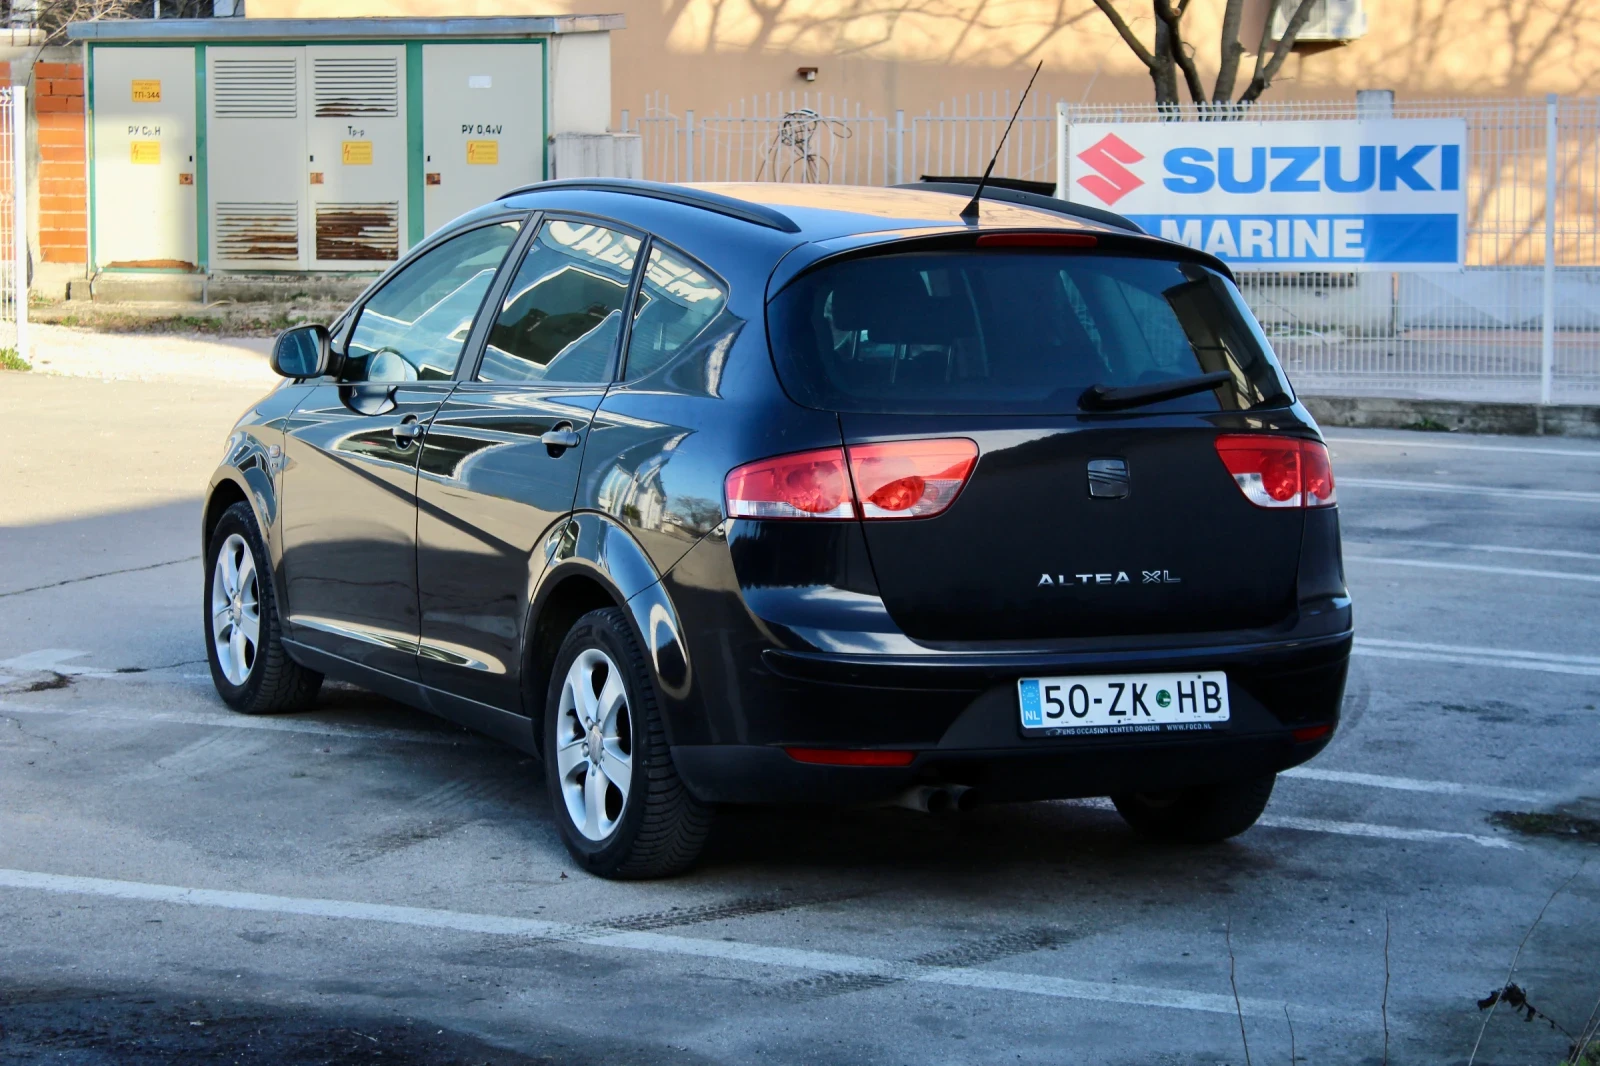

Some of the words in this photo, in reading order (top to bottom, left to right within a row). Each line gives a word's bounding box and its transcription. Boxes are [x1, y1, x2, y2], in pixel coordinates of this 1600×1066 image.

[1162, 145, 1460, 194] SUZUKI
[1161, 219, 1364, 258] MARINE
[1037, 571, 1130, 587] ALTEA
[1142, 569, 1181, 584] XL
[1025, 710, 1041, 721] NL
[1076, 727, 1109, 735] OCCASION
[1109, 726, 1134, 734] CENTER
